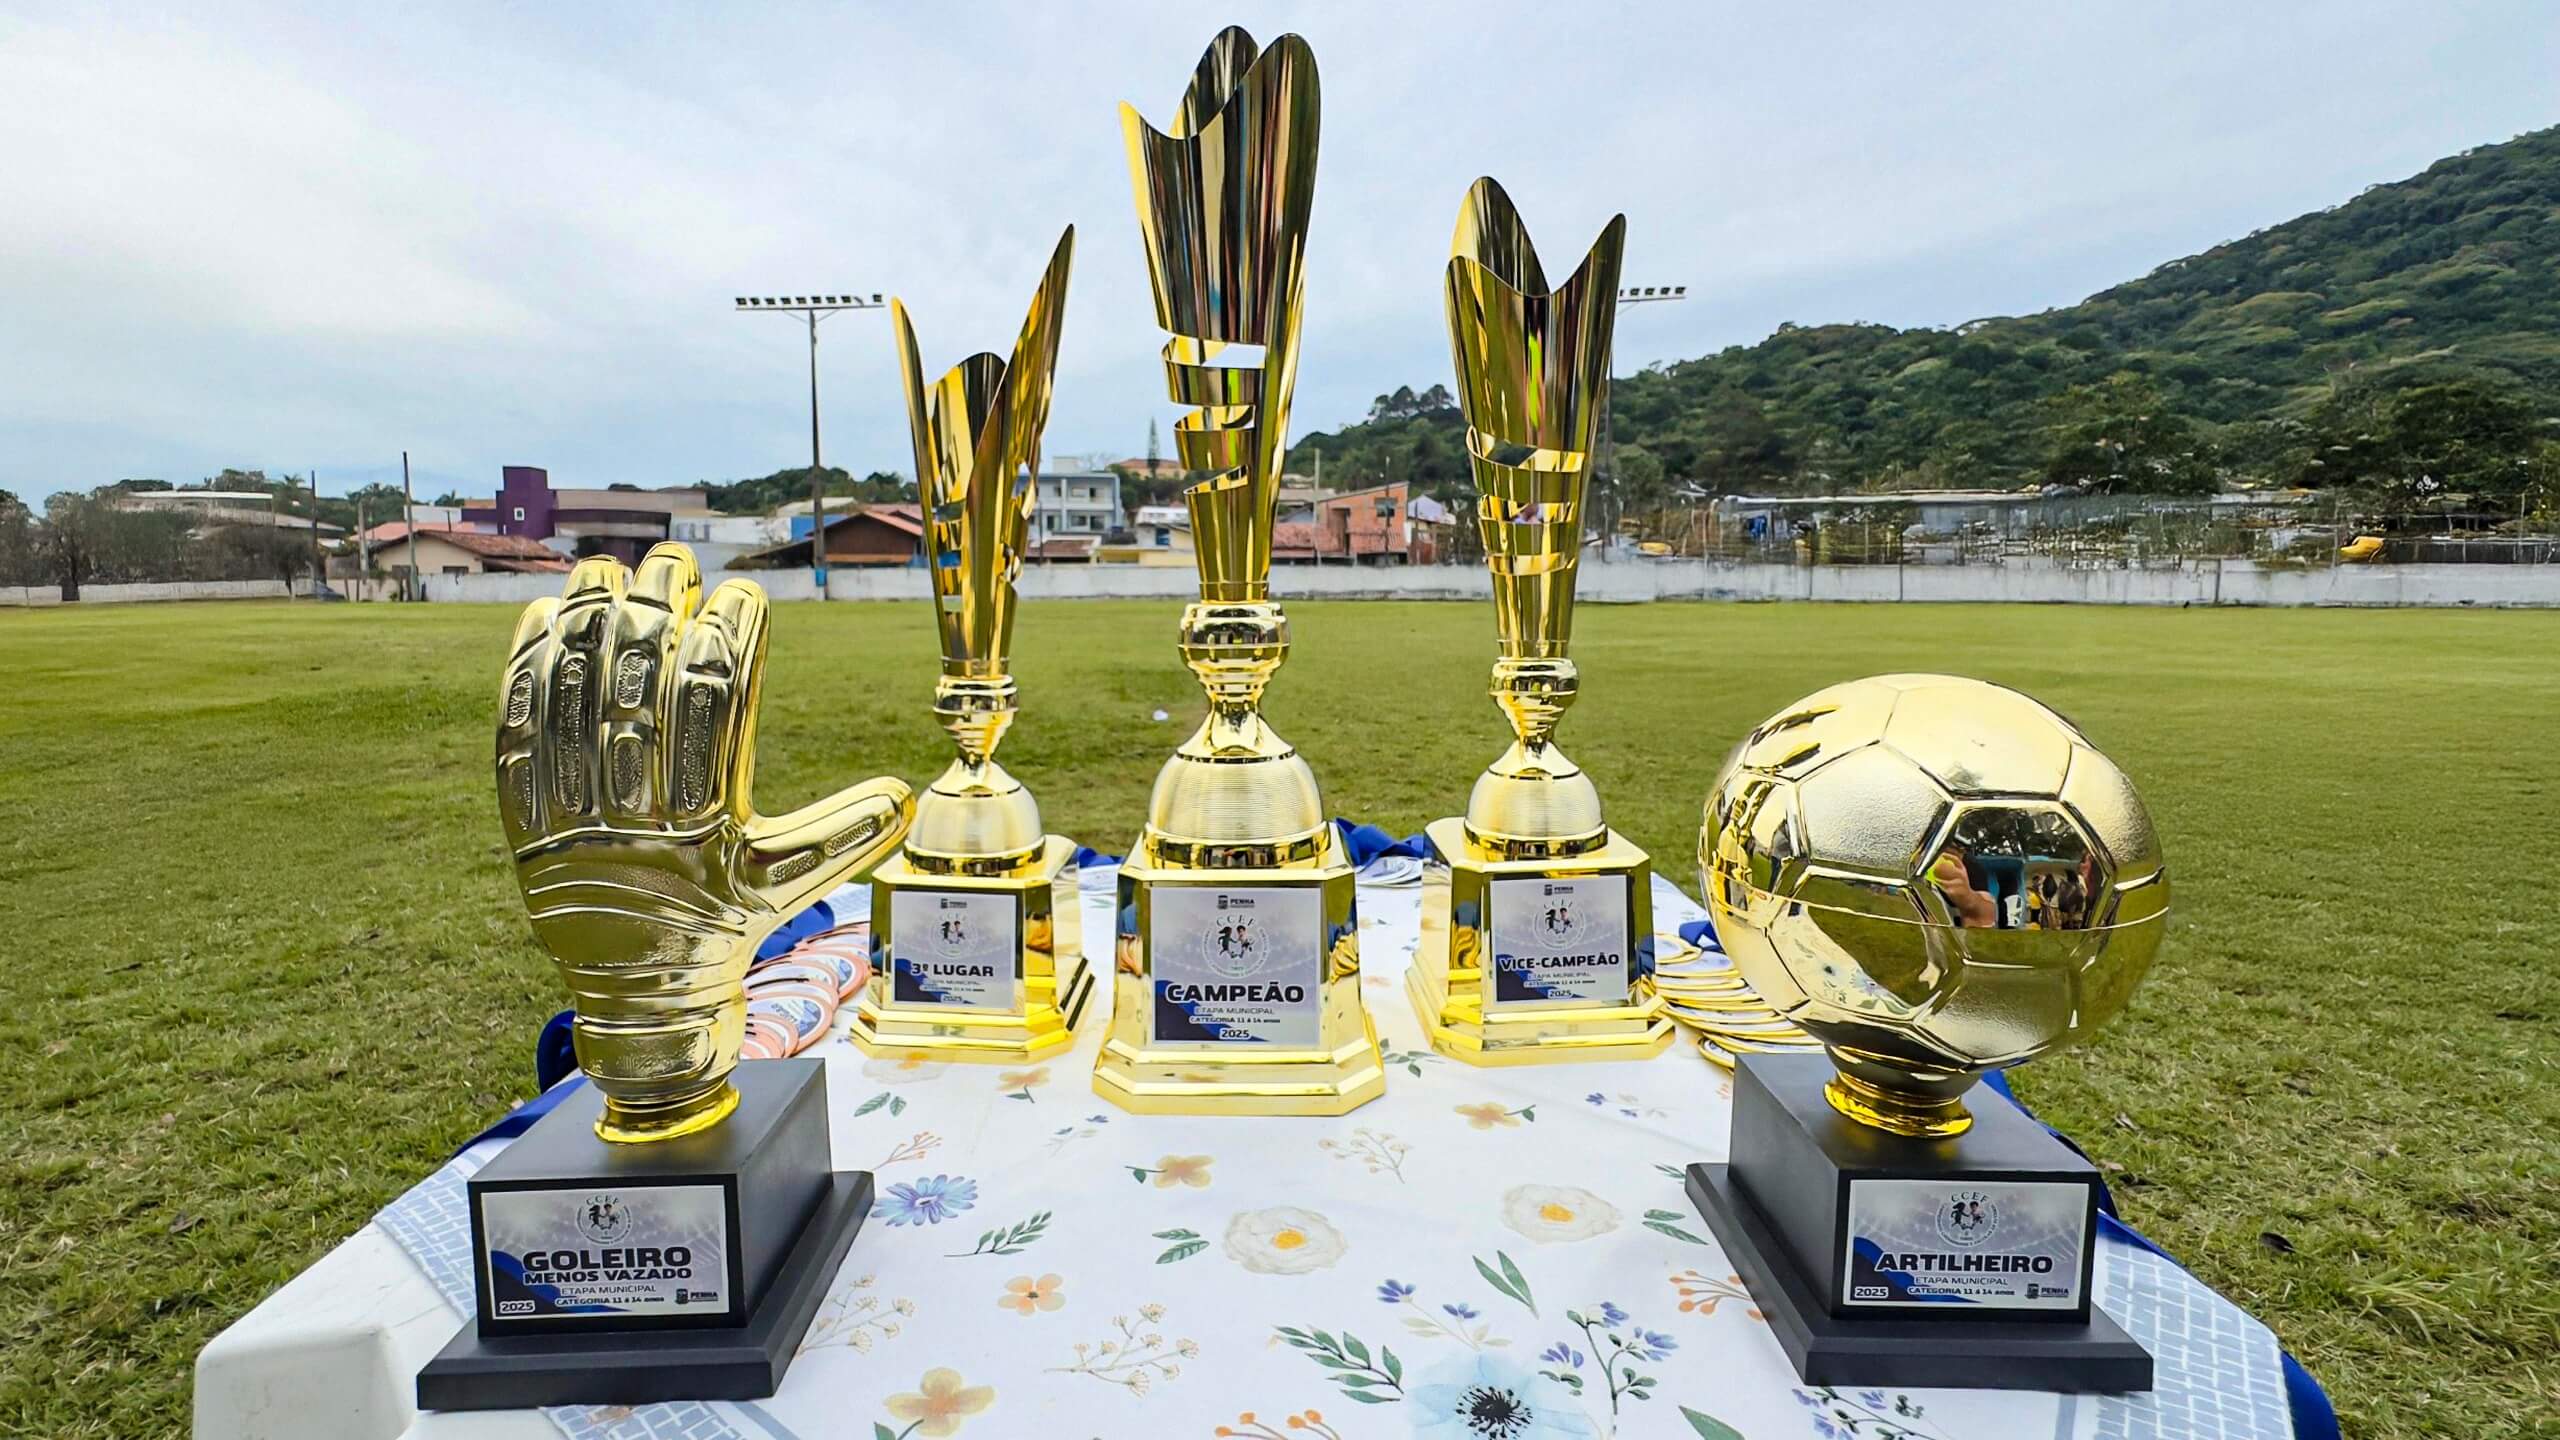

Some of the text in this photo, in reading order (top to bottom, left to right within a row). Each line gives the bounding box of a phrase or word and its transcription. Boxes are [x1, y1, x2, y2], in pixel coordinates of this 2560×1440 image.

[1501, 952, 1619, 970] VICE-CAMPEÃO
[912, 963, 994, 977] 3º LUGAR
[1167, 981, 1304, 1003] CAMPEÃO
[1226, 1007, 1274, 1015] MUNICIPAL
[1221, 1029, 1250, 1038] 2025
[1951, 1191, 1988, 1203] CCEF
[523, 1246, 692, 1271] GOLEIRO
[1876, 1253, 2053, 1273] ARTILHEIRO
[525, 1267, 692, 1284] MENOS VAZADO
[1915, 1276, 2009, 1286] ETAPA MUNICIPAL
[562, 1285, 657, 1295] ETAPA MUNICIPAL
[1856, 1288, 1887, 1297] 2025
[501, 1302, 534, 1311] 2025
[556, 1297, 610, 1305] CATEGORIA
